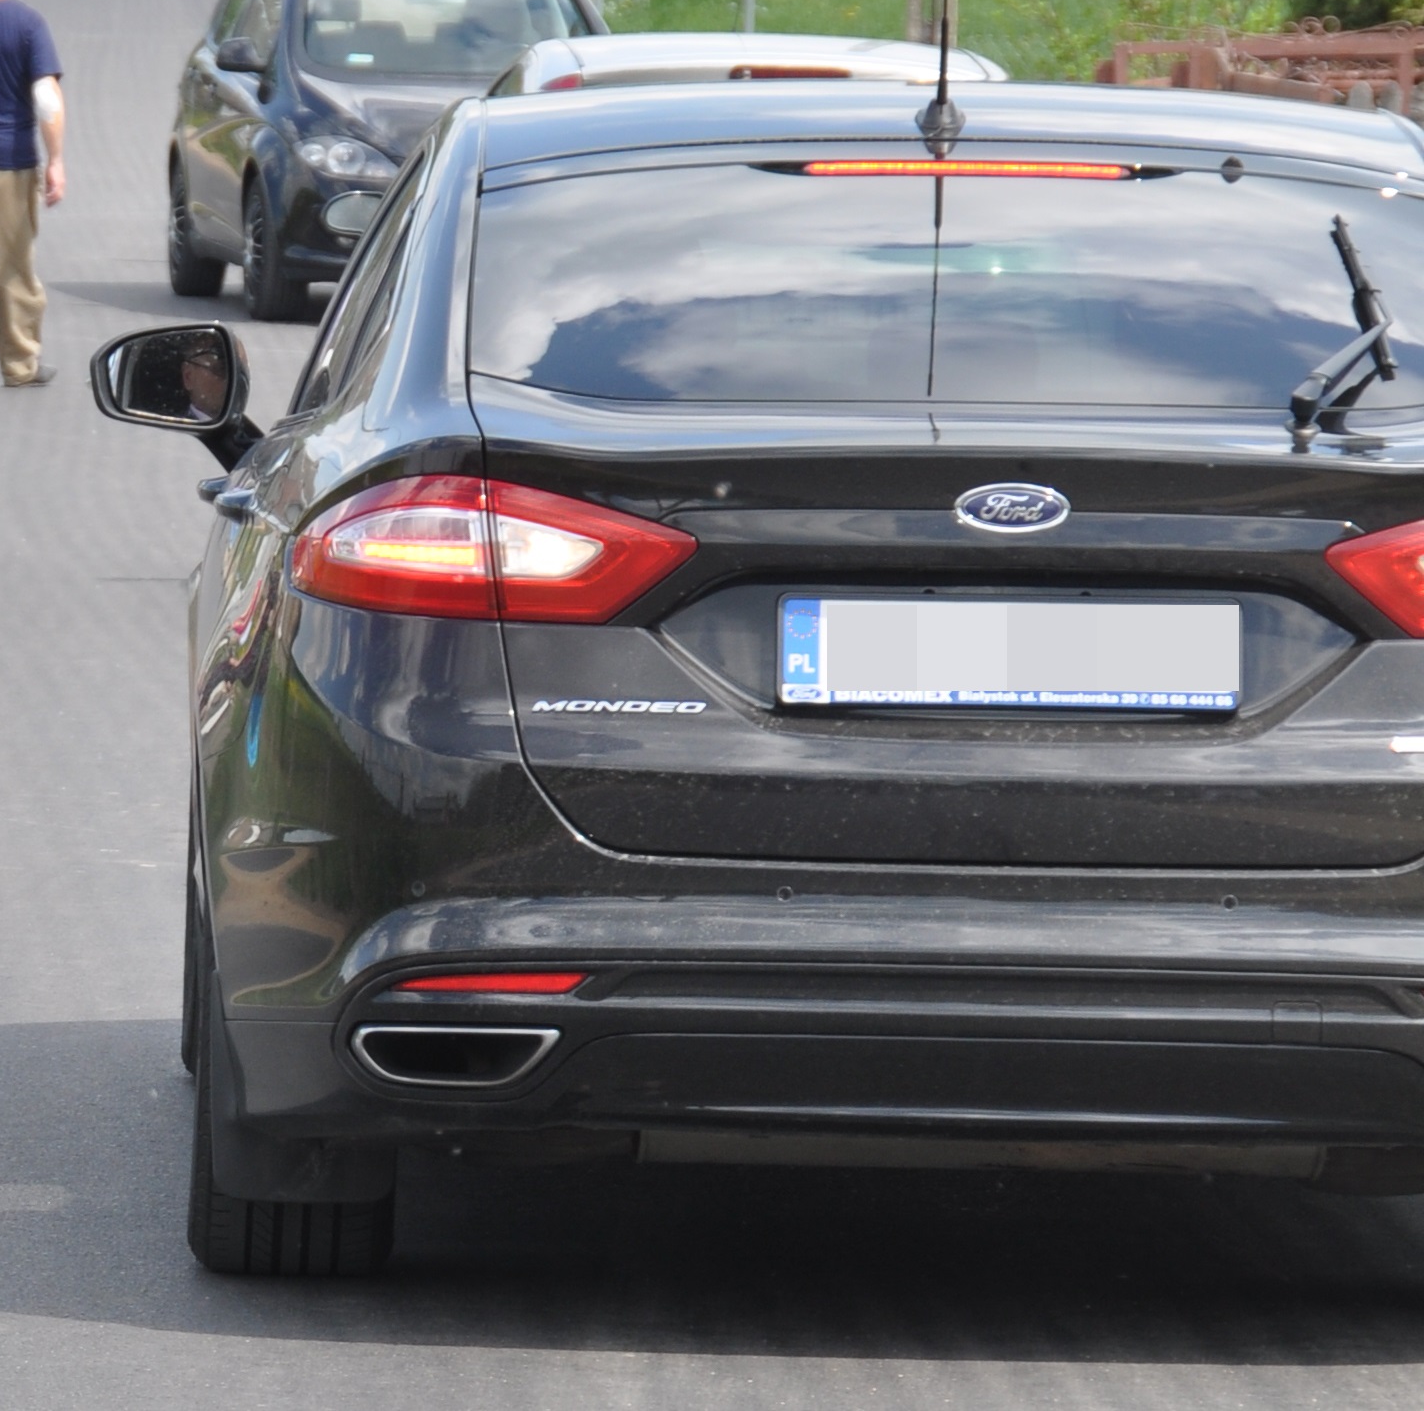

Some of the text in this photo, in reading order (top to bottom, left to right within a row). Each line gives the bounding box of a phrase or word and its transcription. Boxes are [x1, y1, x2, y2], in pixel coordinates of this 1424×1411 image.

[980, 493, 1045, 521] Ford
[788, 653, 816, 673] PL
[531, 699, 708, 714] MONDEO
